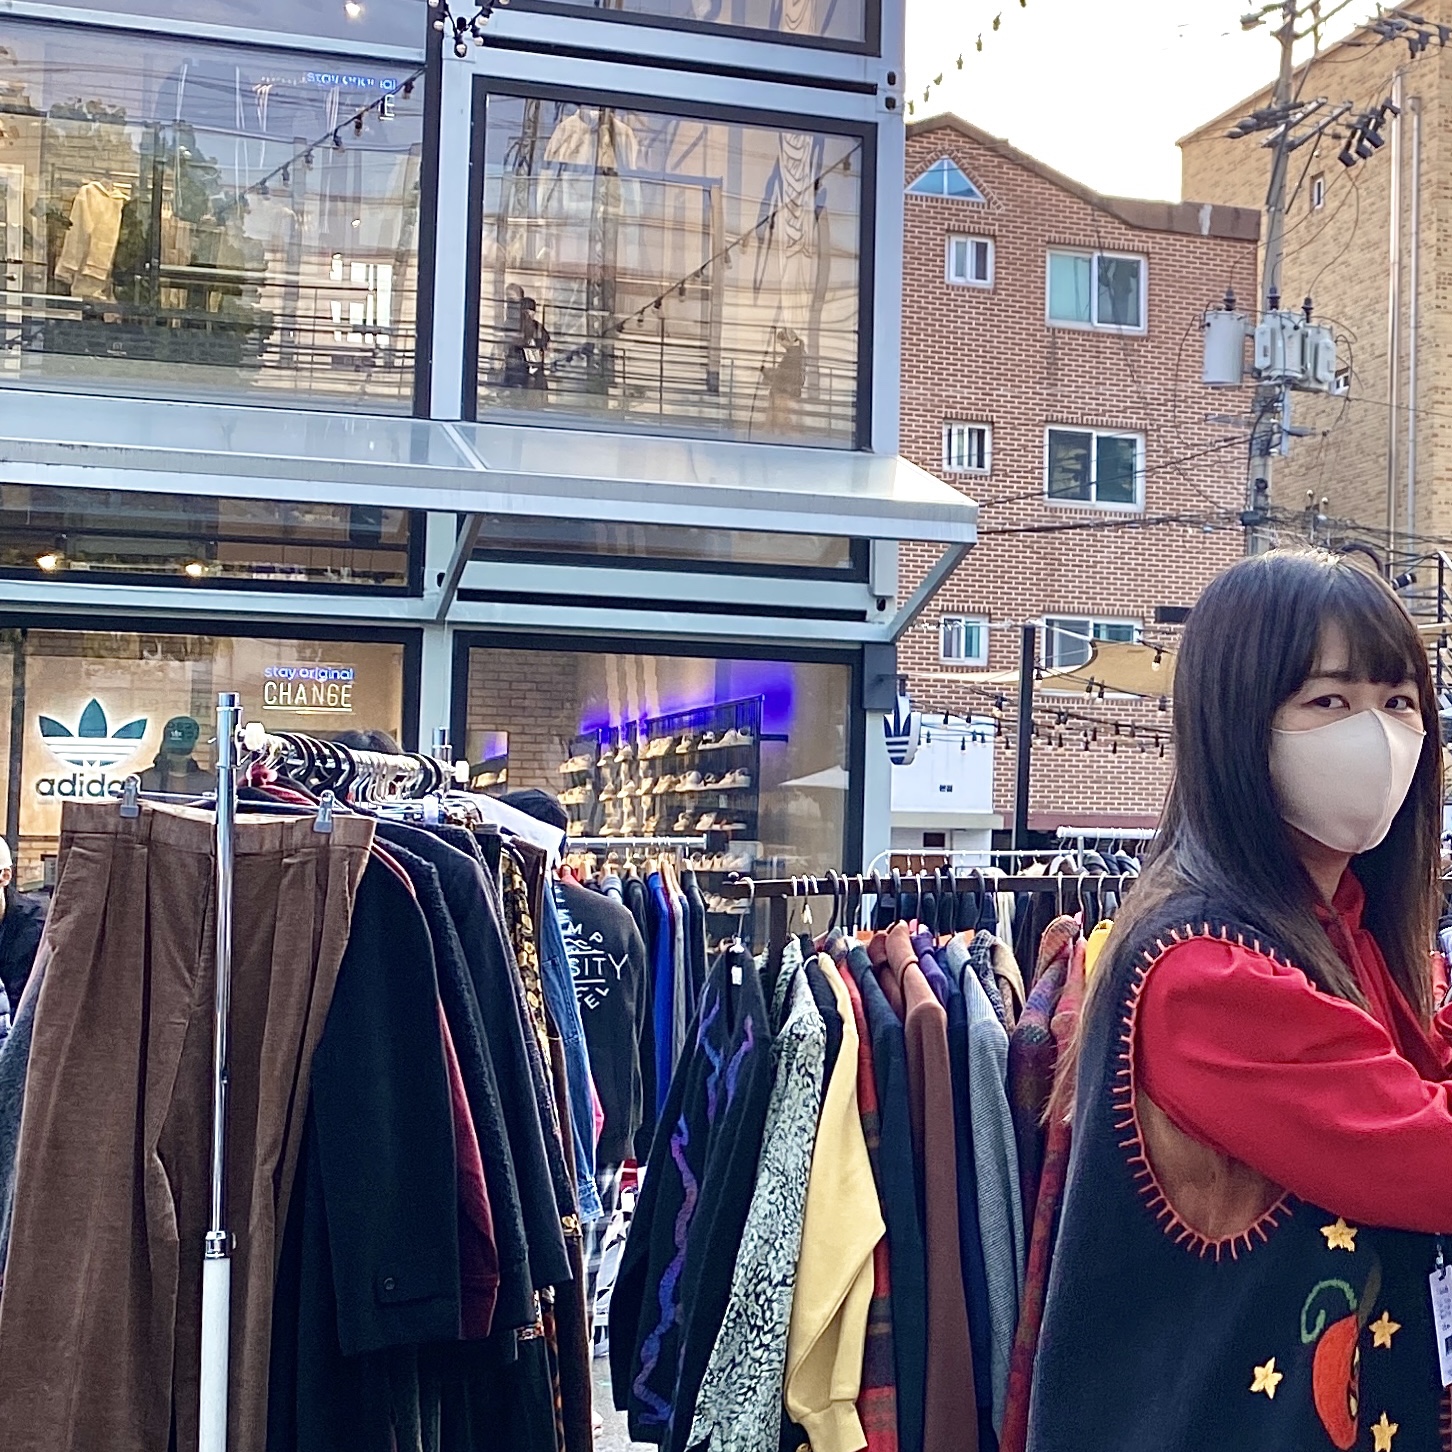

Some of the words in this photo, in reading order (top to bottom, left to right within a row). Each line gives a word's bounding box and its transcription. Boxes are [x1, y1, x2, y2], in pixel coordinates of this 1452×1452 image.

[264, 665, 296, 681] stay
[299, 666, 354, 684] original
[263, 681, 353, 708] CHANGE
[35, 773, 126, 798] adida
[570, 952, 629, 981] SITY
